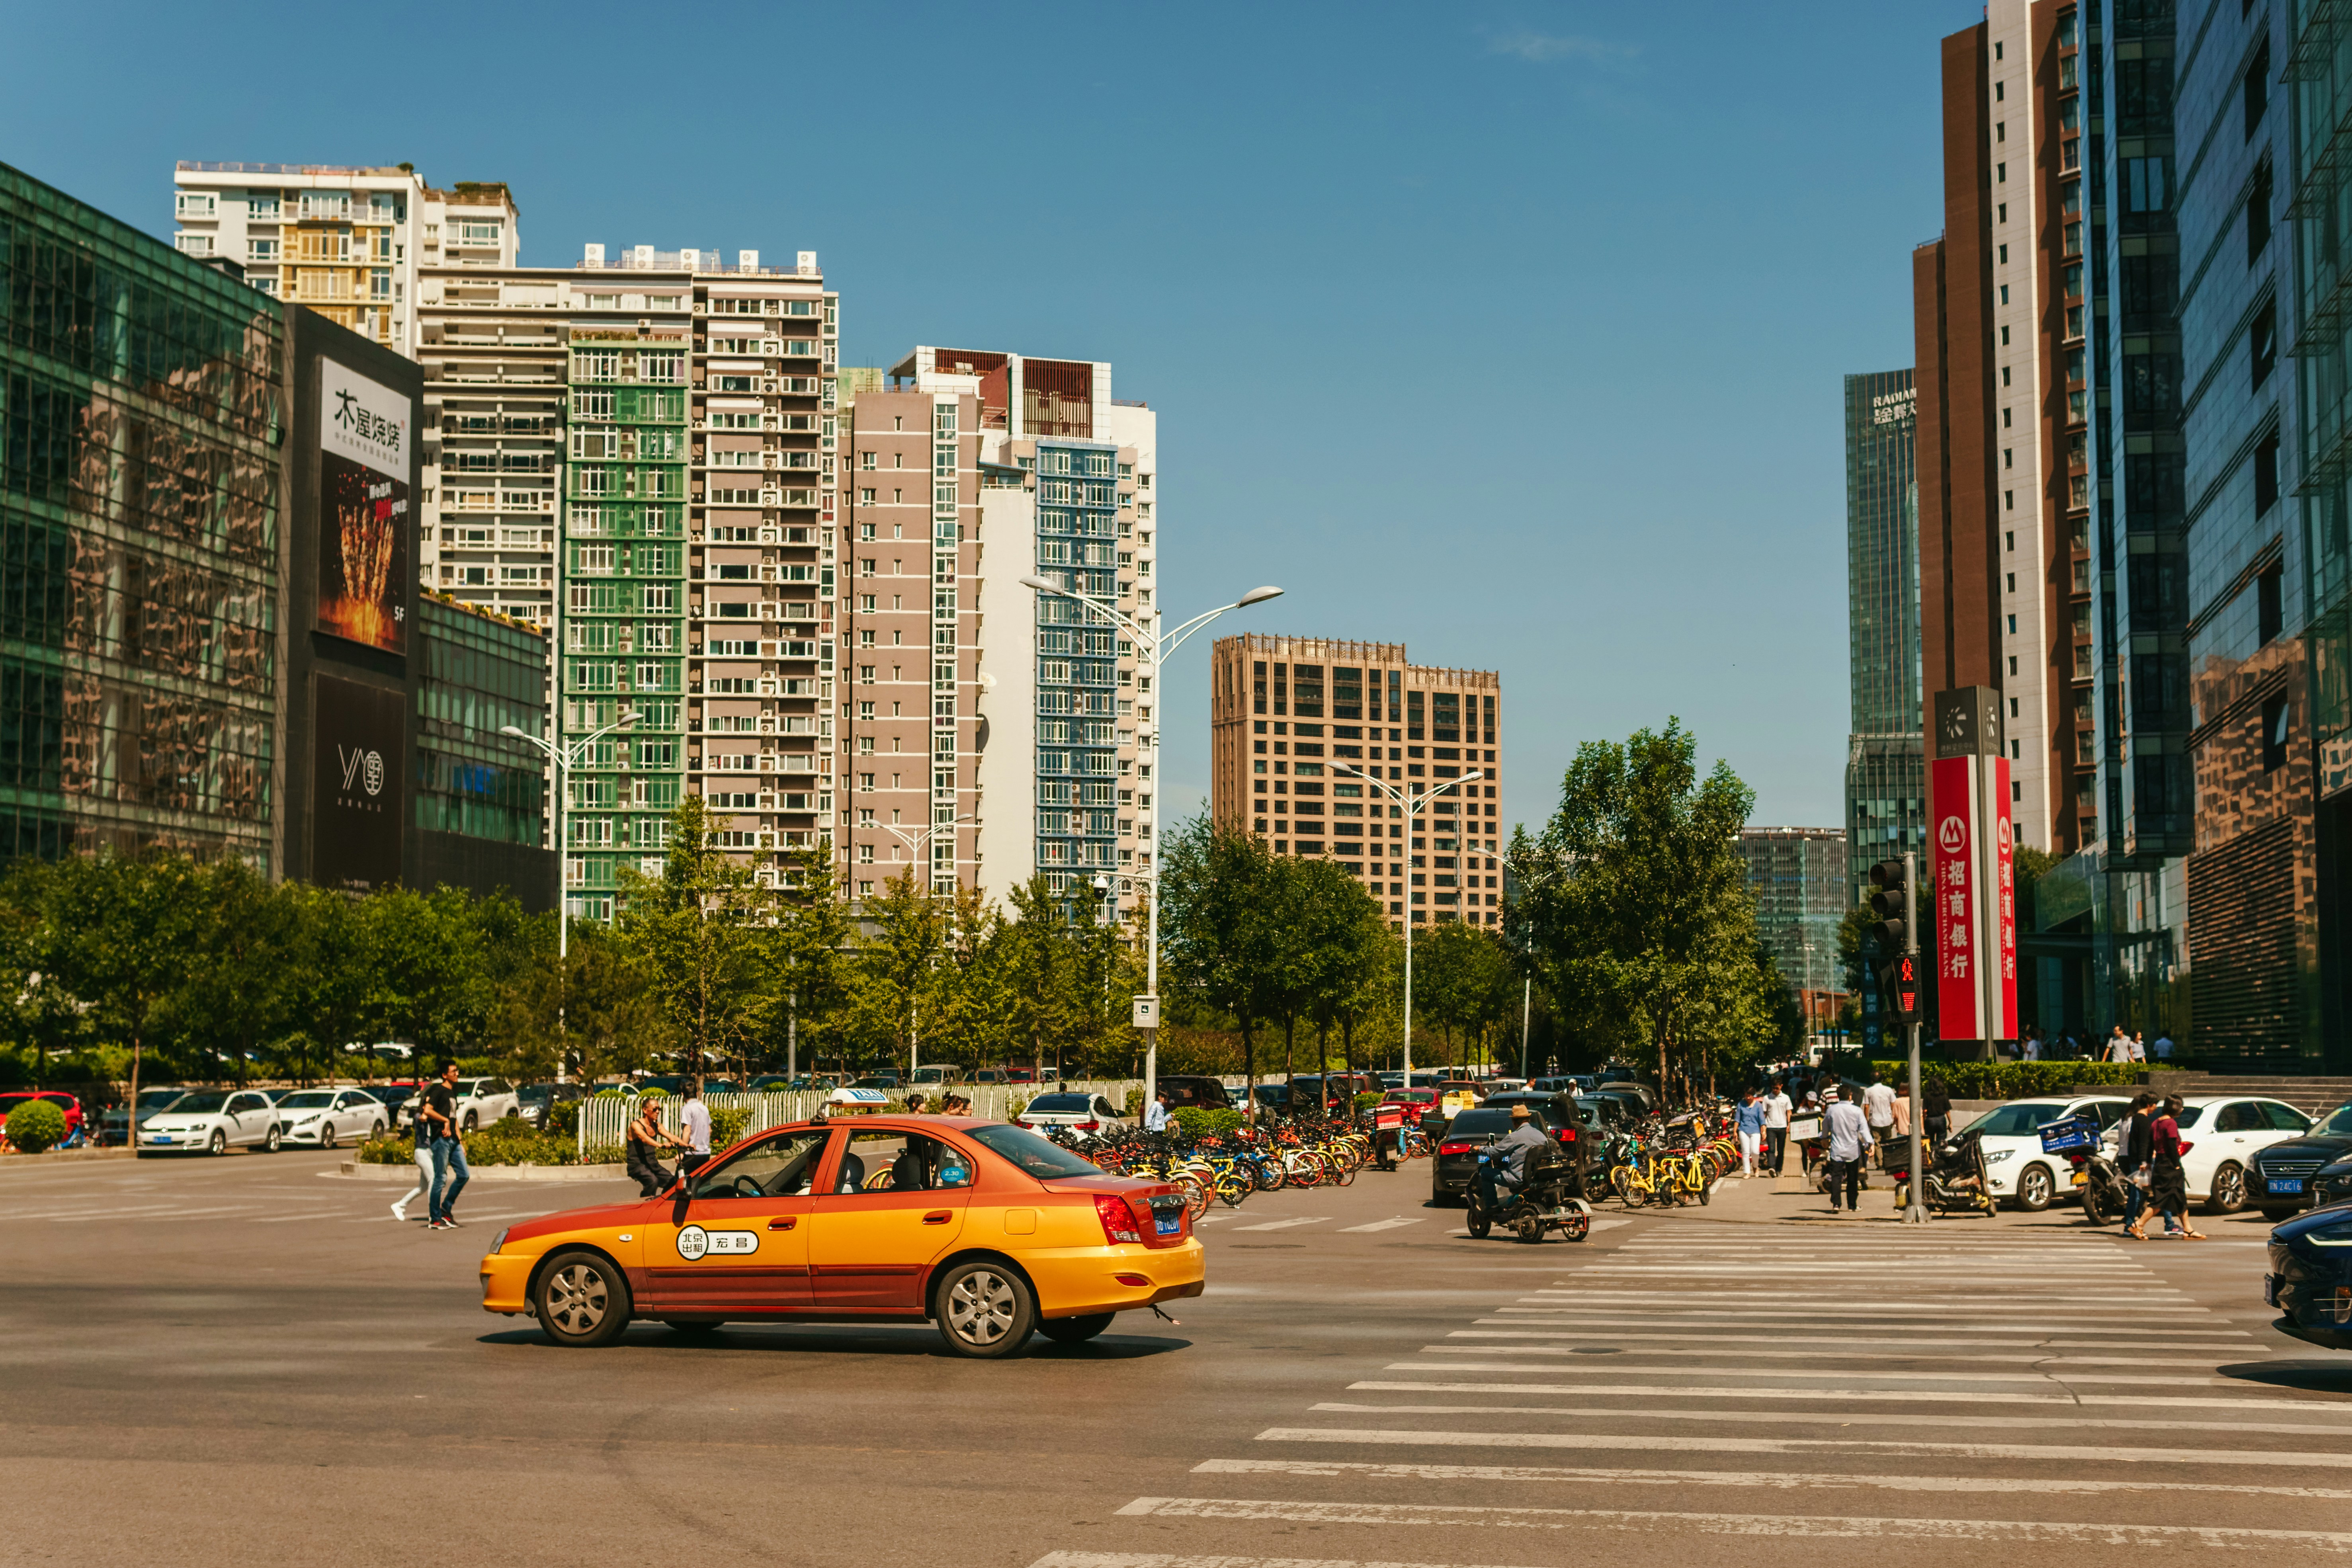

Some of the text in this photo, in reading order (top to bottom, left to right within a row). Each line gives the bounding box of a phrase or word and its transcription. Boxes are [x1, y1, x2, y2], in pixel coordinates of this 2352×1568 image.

[334, 389, 399, 452] 木屋烧烤
[394, 605, 404, 622] 5F
[683, 1233, 702, 1242] 北京
[716, 1238, 748, 1248] 宏昌
[683, 1244, 702, 1253] 出租
